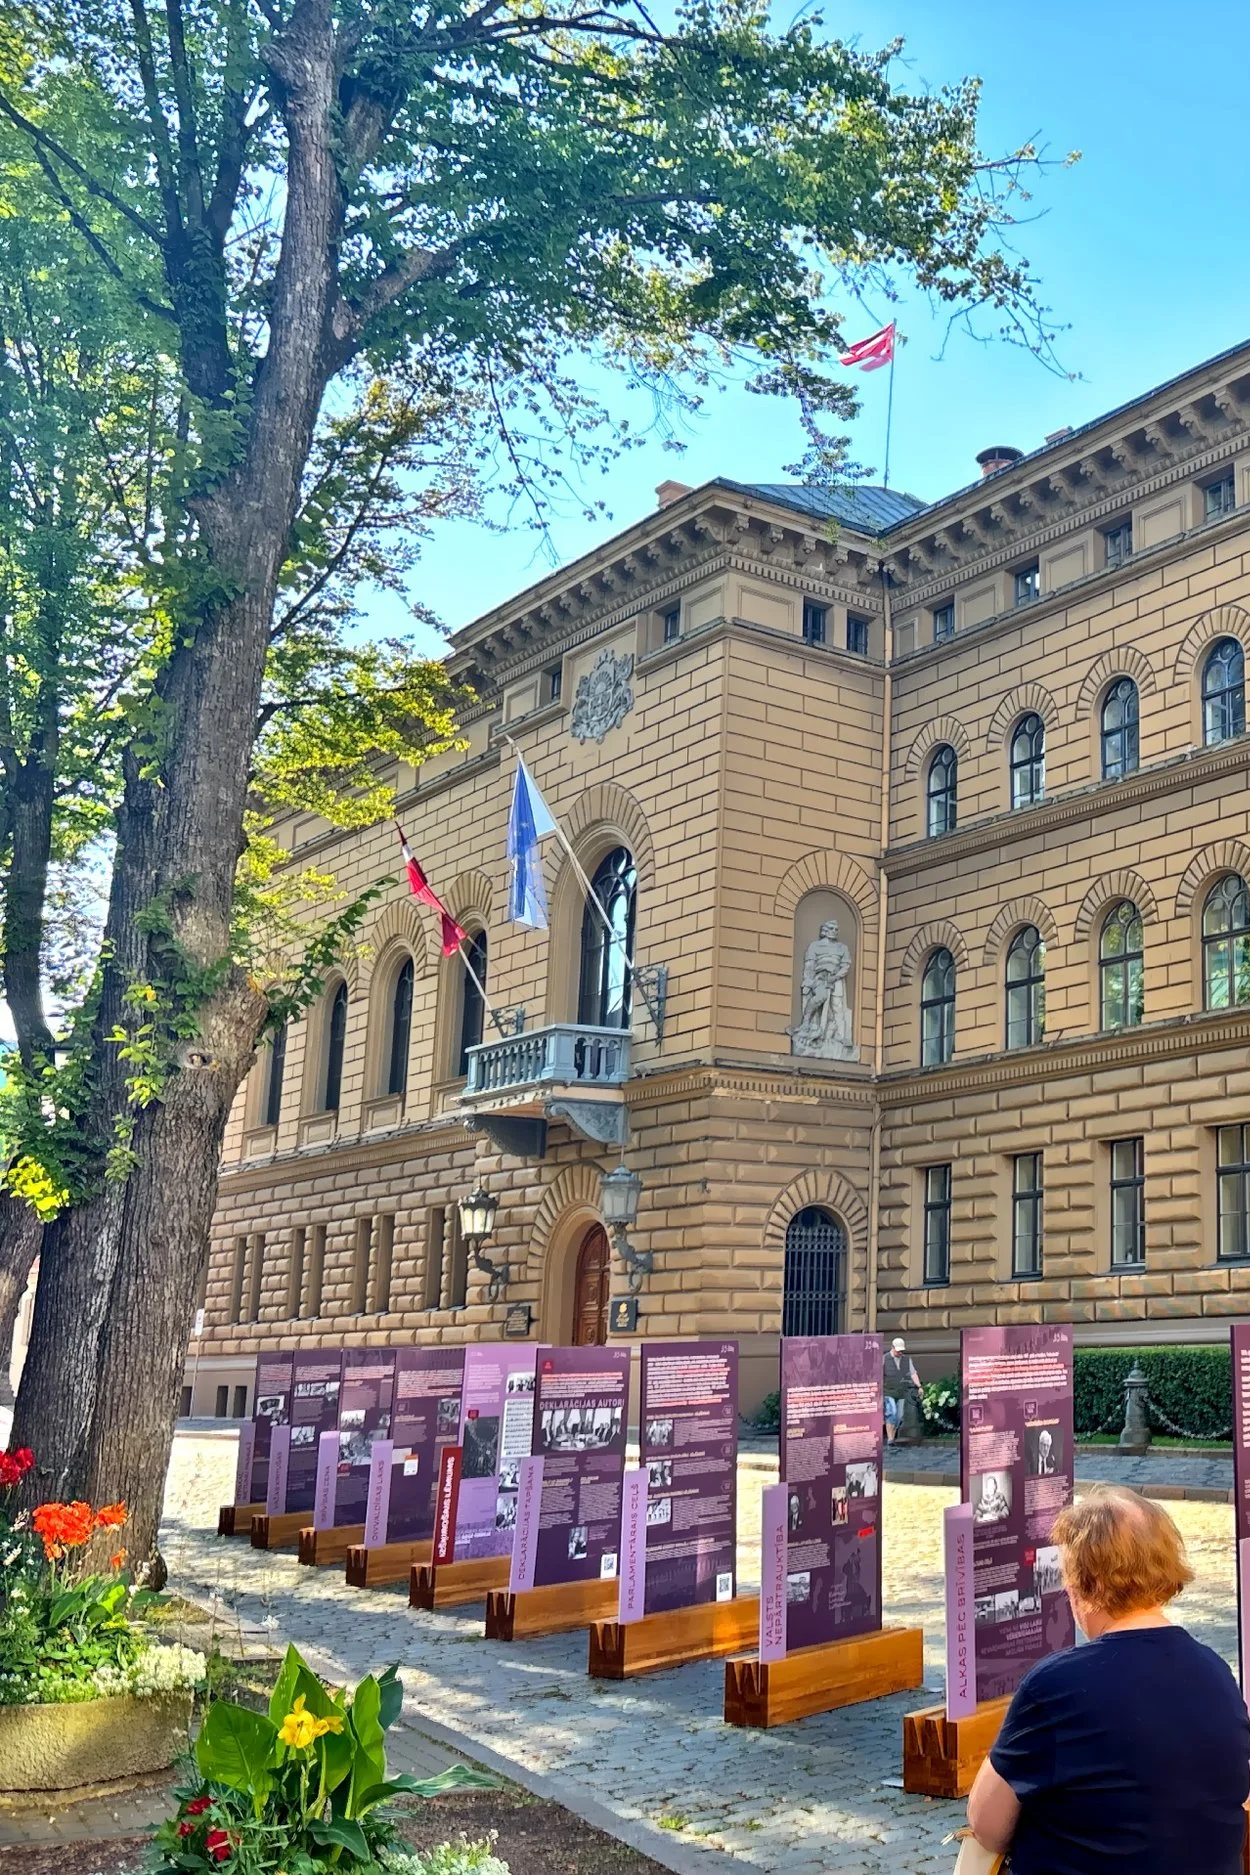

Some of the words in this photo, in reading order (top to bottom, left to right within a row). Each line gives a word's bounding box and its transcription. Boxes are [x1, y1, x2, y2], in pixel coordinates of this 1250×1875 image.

[597, 1398, 625, 1408] AUTORI
[376, 1460, 385, 1484] LAIKS
[627, 1513, 638, 1609] PARLAMENTĀRAIS
[774, 1524, 784, 1645] NEPĀRTRAUKTĪBA
[955, 1533, 966, 1607] BRĪVĪBAS
[765, 1596, 774, 1647] VALSTS
[958, 1646, 968, 1698] ALKAS
